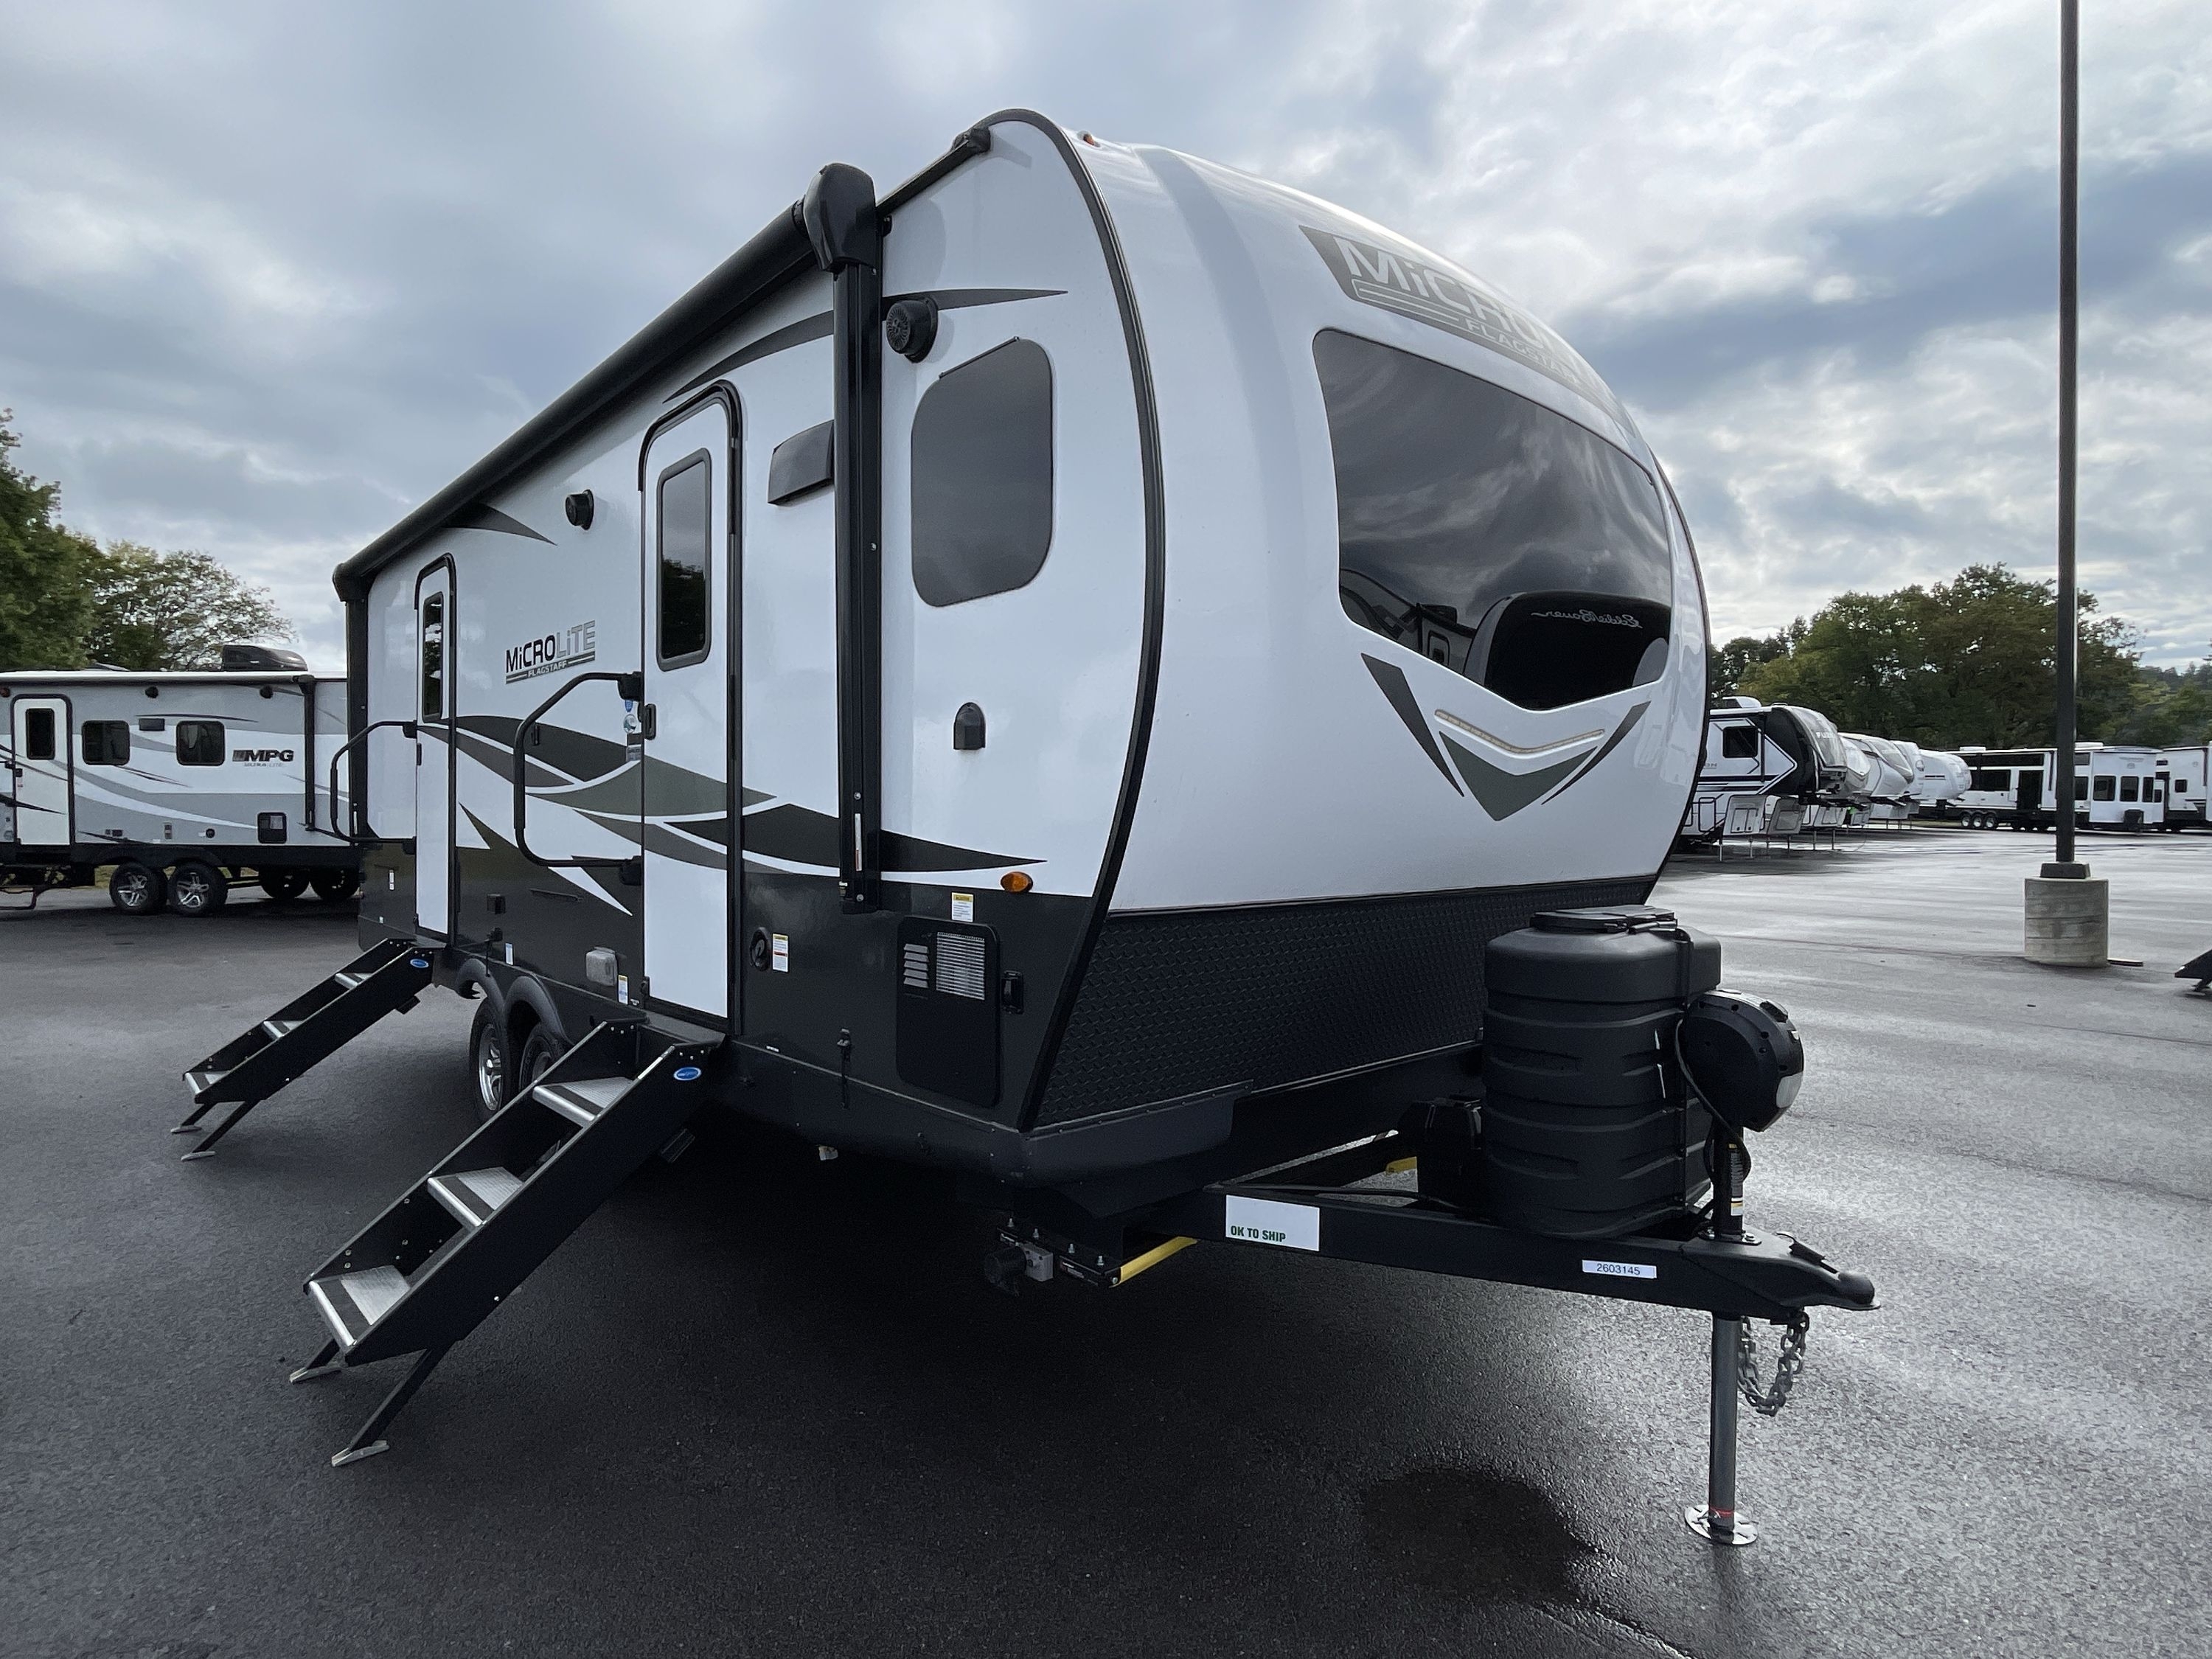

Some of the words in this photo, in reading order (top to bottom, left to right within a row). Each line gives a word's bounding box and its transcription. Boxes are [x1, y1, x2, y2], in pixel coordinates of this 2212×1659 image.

[528, 661, 567, 678] FLAGSTAFF
[244, 749, 294, 762] MPG
[1231, 1225, 1245, 1237] OK
[1247, 1228, 1259, 1239] TO
[1262, 1230, 1286, 1242] SHIP
[1596, 1263, 1641, 1275] 2603145
